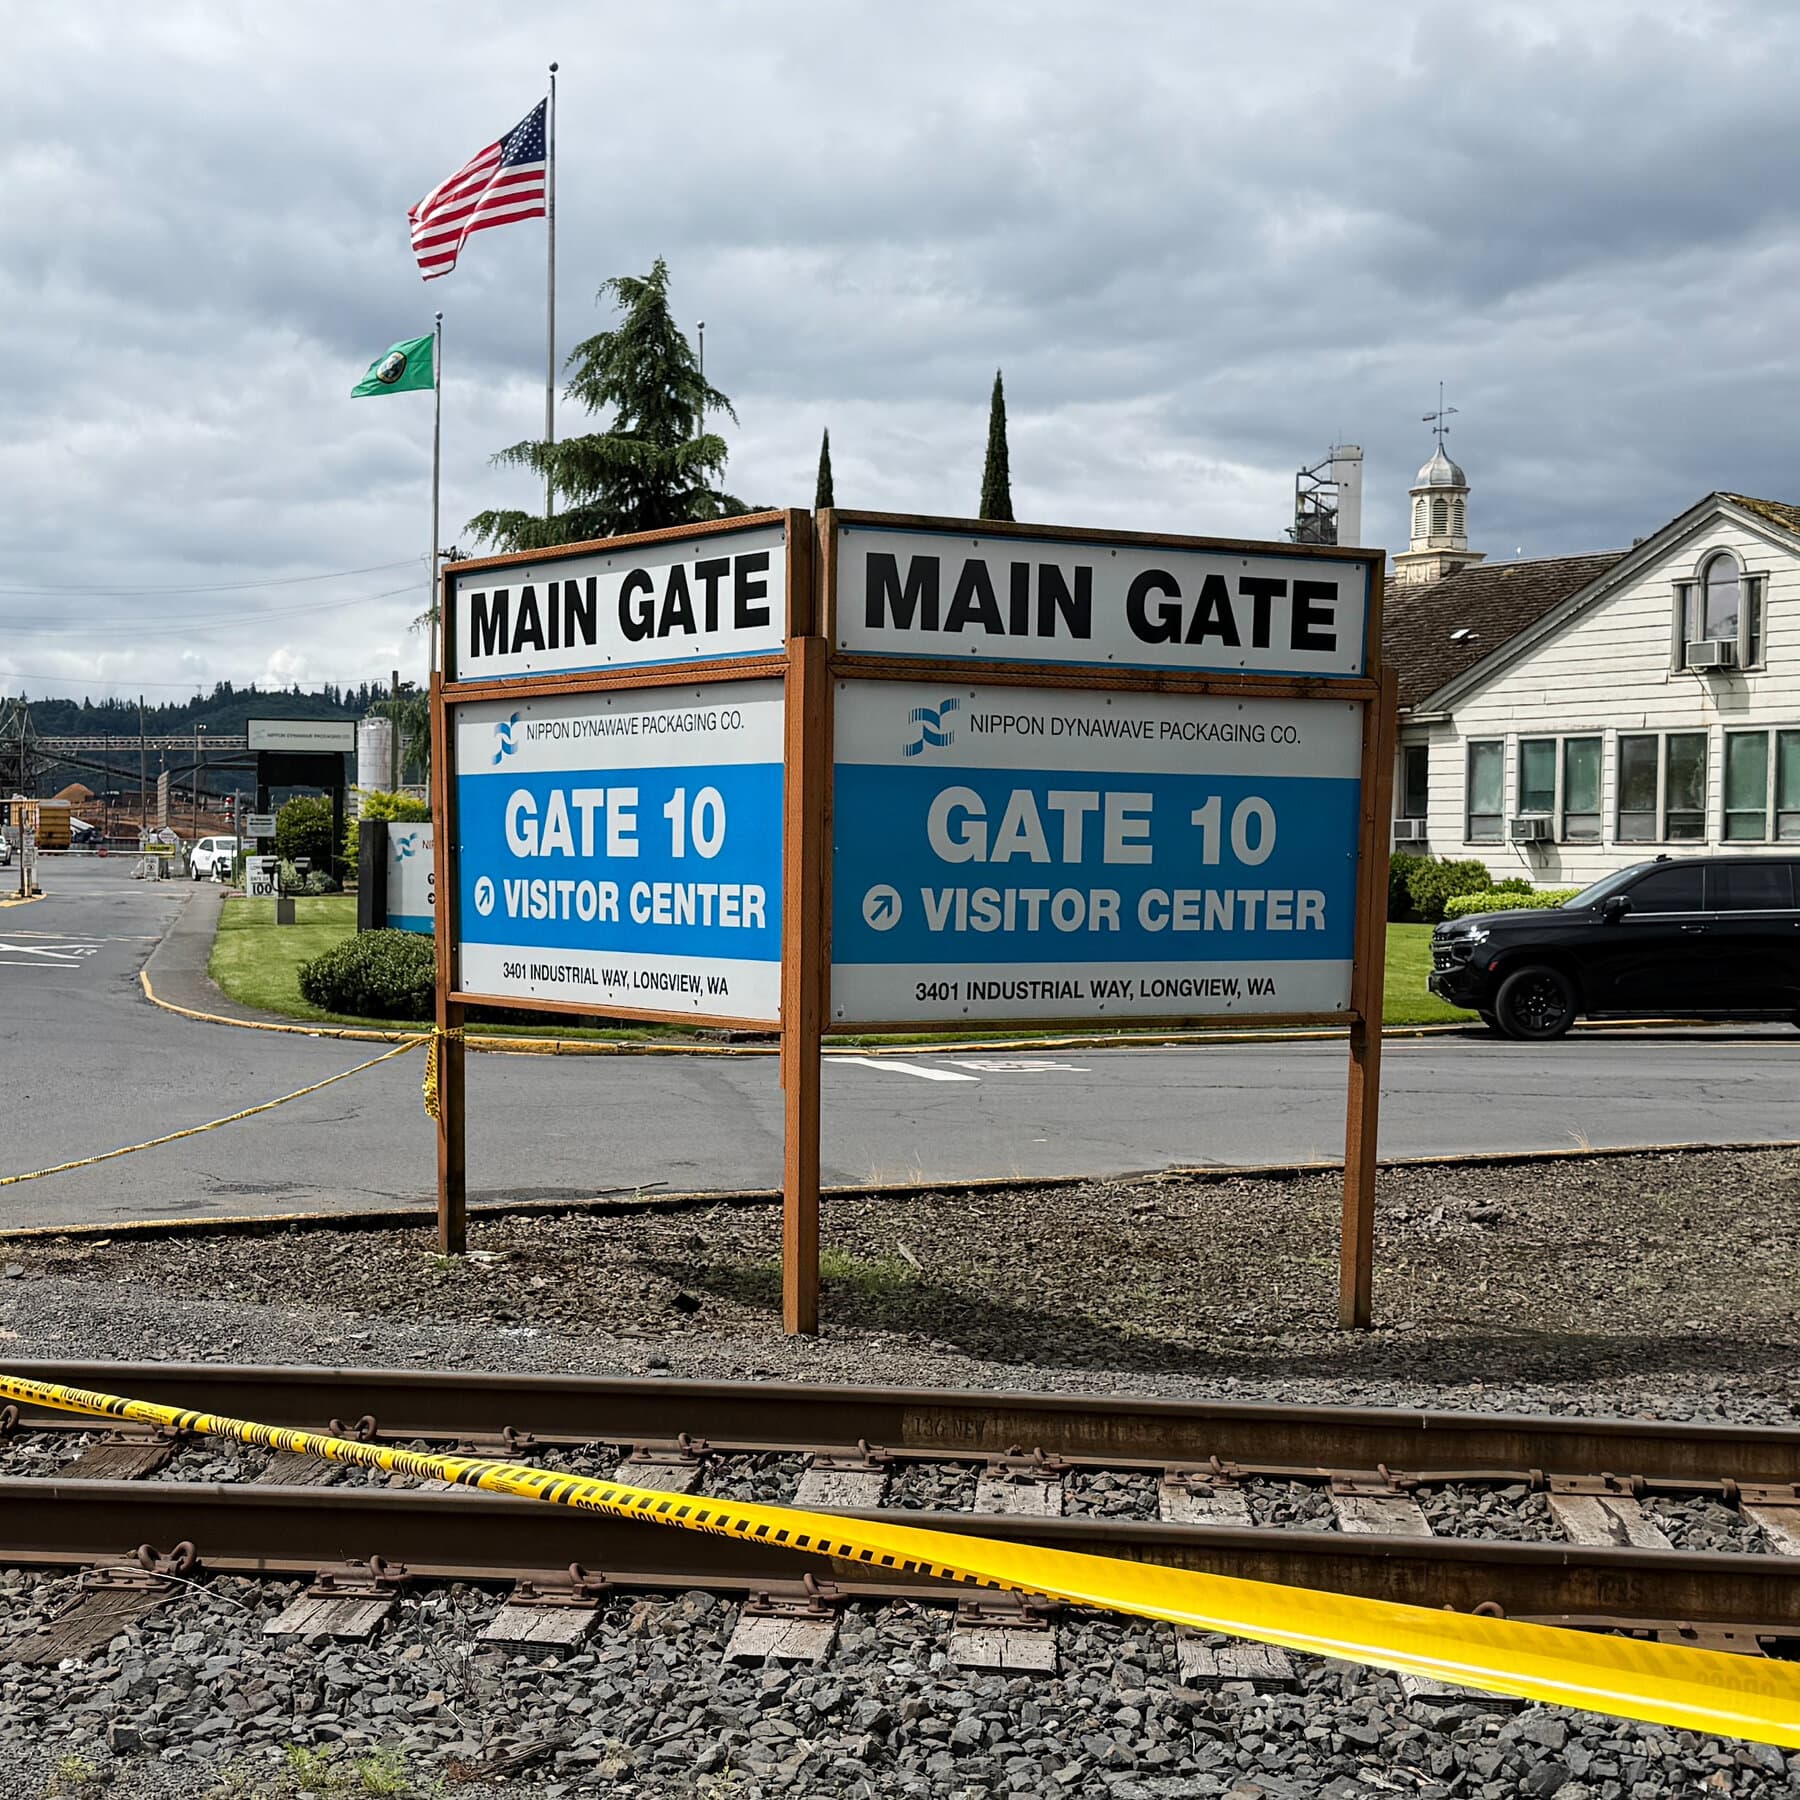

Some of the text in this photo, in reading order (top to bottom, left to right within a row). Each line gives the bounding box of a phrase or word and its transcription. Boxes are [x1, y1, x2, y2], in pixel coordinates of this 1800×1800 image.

[470, 551, 770, 658] MAIN GATE
[865, 552, 1339, 652] MAIN GATE
[526, 710, 745, 740] NIPPON DYNAWAVE PACKAGING CO.
[969, 714, 1302, 745] NIPPON DYNAWAVE PACKAGING CO.
[505, 786, 726, 859] GATE 10
[927, 785, 1277, 866] GATE 10
[503, 879, 766, 929] VISITOR CENTER
[920, 886, 1327, 933] VISITOR CENTER
[503, 962, 729, 996] 3401 INDUSTRIAL WAY, LONGVIEW, WA
[915, 977, 1276, 1001] 3401 INDUSTRIAL WAY, LONGVIEW, WA
